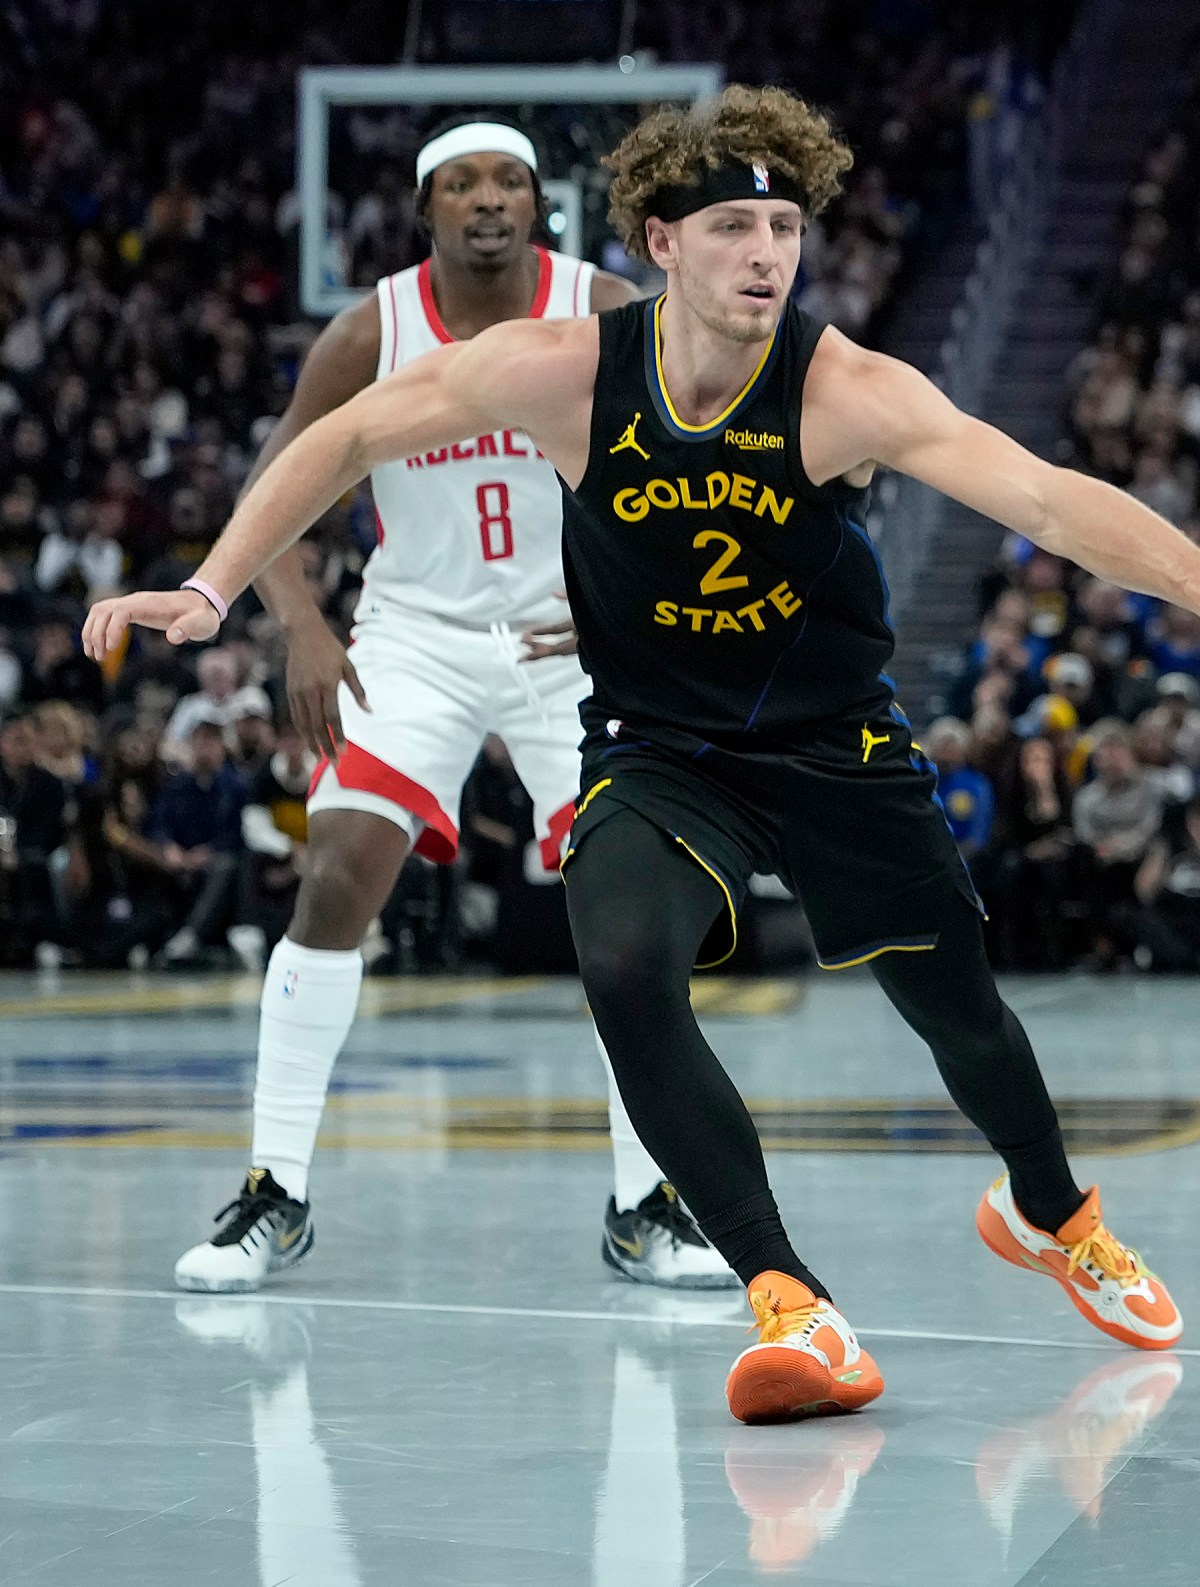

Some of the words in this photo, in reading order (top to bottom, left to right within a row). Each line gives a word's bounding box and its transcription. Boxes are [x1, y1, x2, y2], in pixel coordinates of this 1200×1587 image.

[725, 429, 784, 449] Rakuten
[476, 482, 514, 561] 8
[613, 471, 794, 525] GOLDEN
[692, 530, 749, 595] 2
[654, 581, 802, 633] STATE
